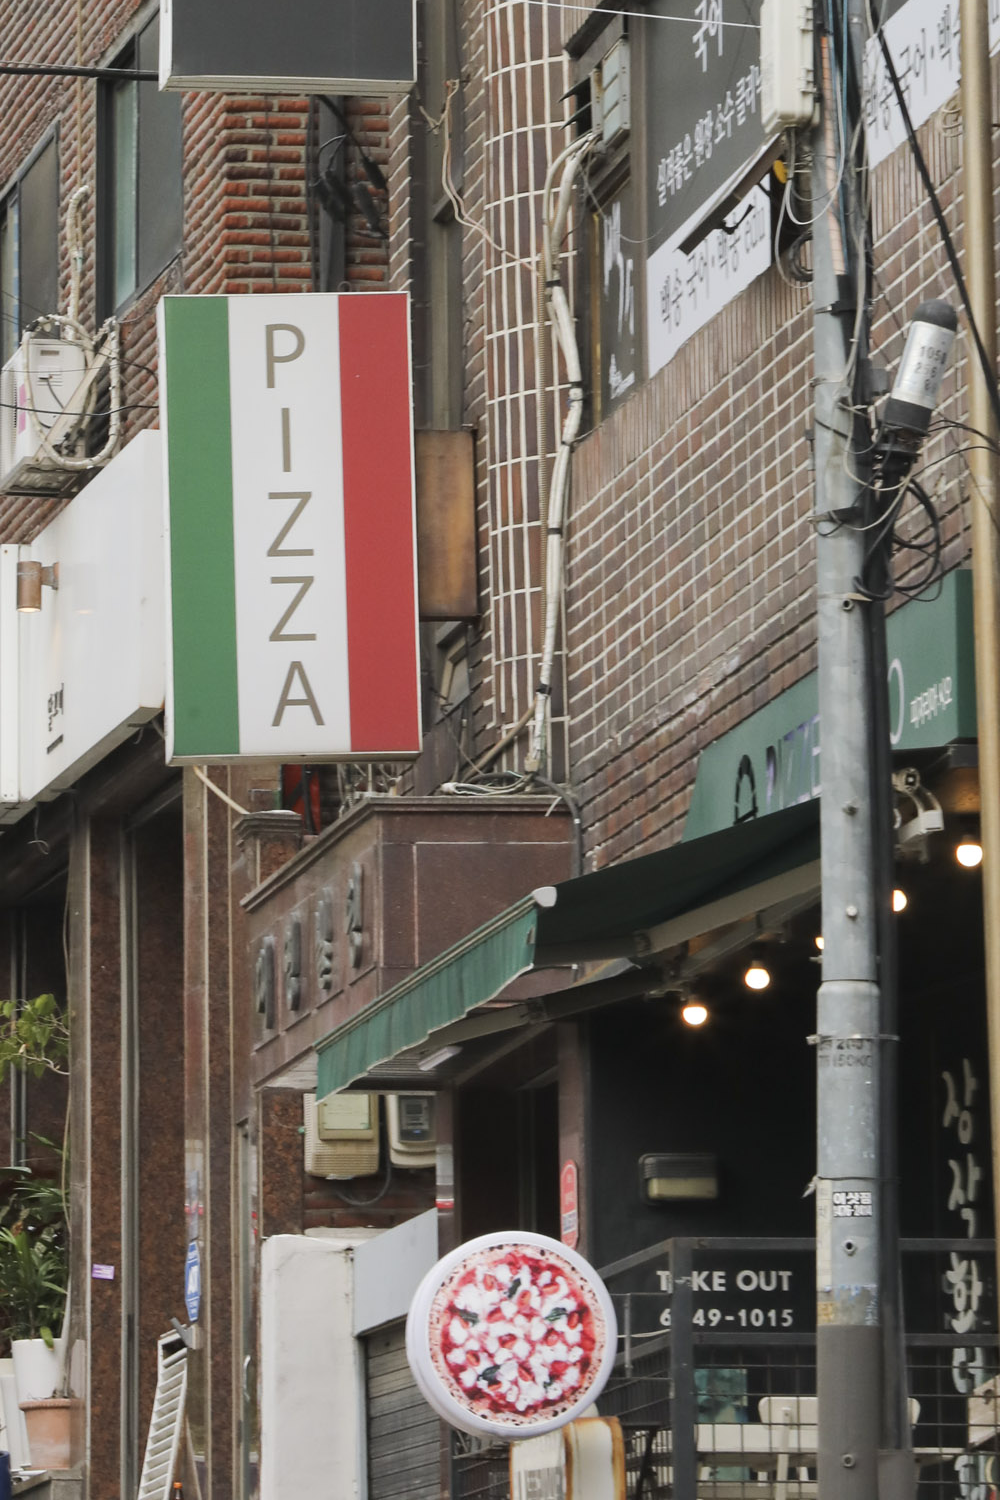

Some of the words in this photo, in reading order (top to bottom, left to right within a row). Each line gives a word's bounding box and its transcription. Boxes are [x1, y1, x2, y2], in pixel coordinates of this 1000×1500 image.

[264, 323, 326, 727] PIZZA
[656, 1270, 726, 1293] TKE
[736, 1269, 793, 1293] OUT
[660, 1308, 793, 1327] 649-1015
